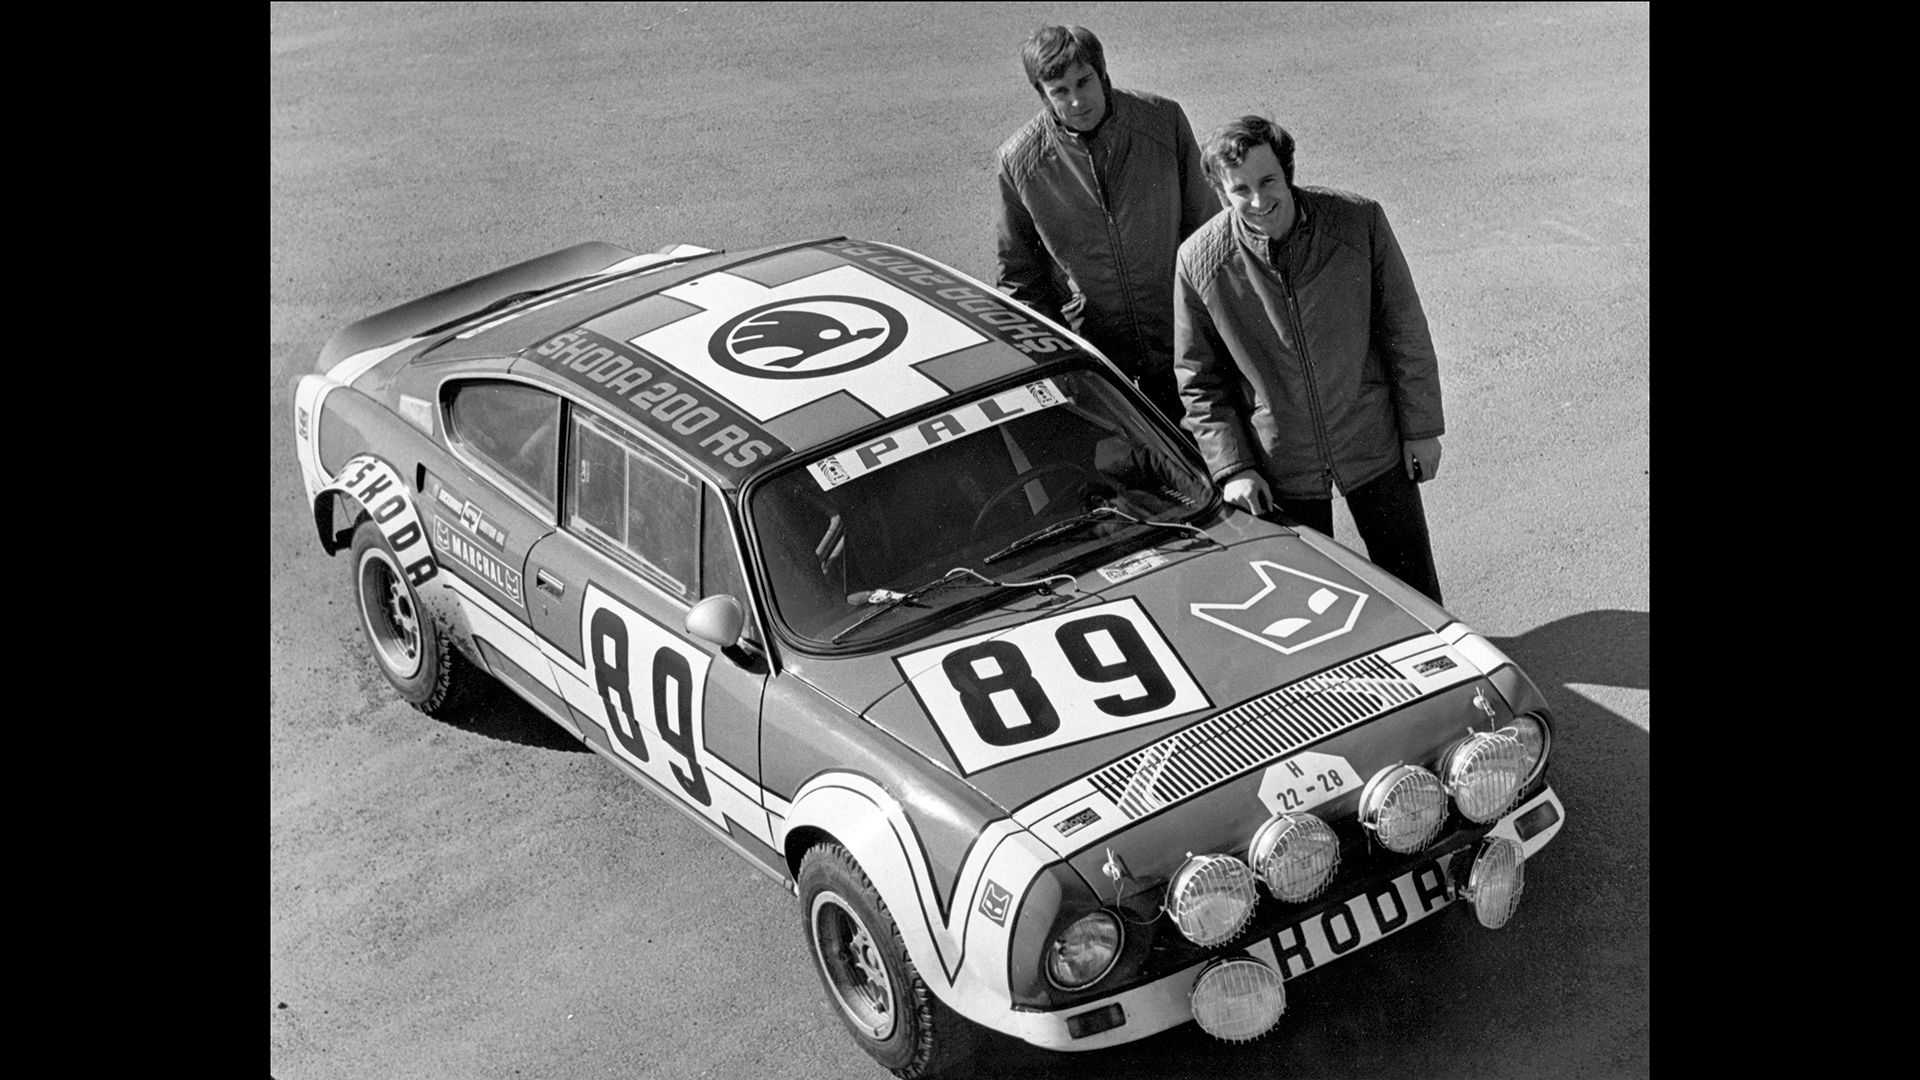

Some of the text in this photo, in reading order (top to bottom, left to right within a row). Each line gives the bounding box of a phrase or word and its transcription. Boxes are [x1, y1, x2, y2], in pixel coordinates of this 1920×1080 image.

[866, 256, 956, 286] 200
[629, 382, 720, 436] 200
[699, 424, 773, 468] RS
[856, 398, 1026, 470] PAL
[452, 534, 504, 587] MARCHAL
[591, 607, 713, 807] 89
[942, 614, 1177, 747] 89
[1285, 761, 1304, 778] H
[1269, 860, 1450, 980] KODA
